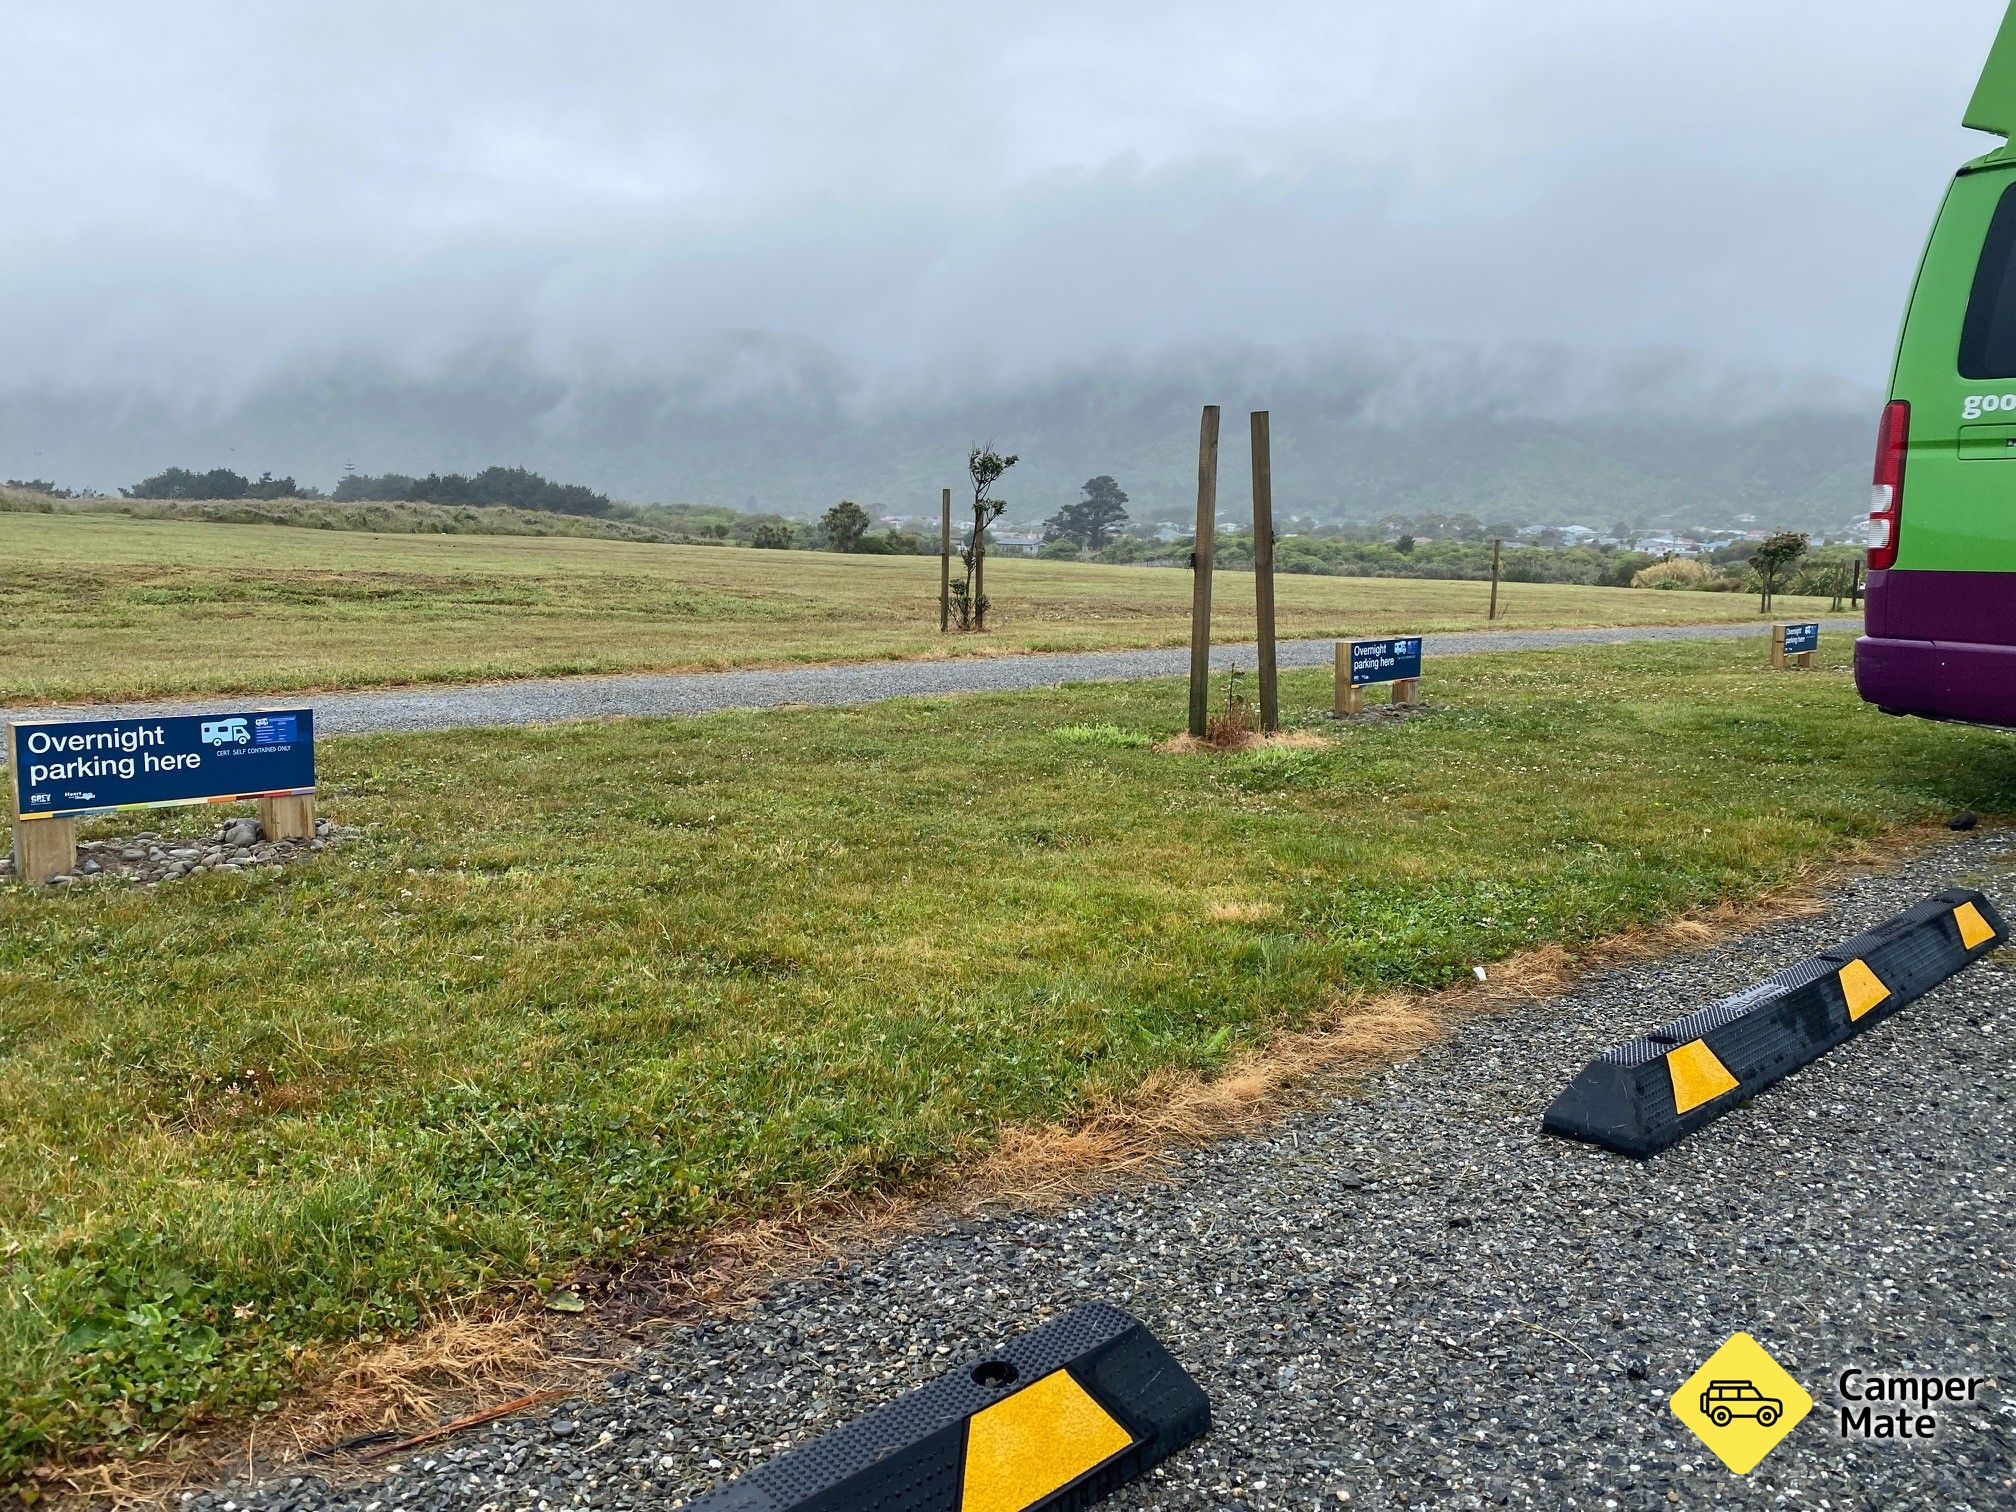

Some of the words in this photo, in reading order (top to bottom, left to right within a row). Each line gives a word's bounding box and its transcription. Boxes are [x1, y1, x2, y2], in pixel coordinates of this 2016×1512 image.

[1354, 644, 1387, 656] Overnight
[1354, 658, 1379, 672] parking
[1380, 657, 1395, 667] here
[28, 726, 165, 754] Overnight
[232, 748, 247, 756] SELF
[247, 746, 277, 754] CONTAINED
[30, 755, 135, 786] parking
[143, 752, 201, 772] here
